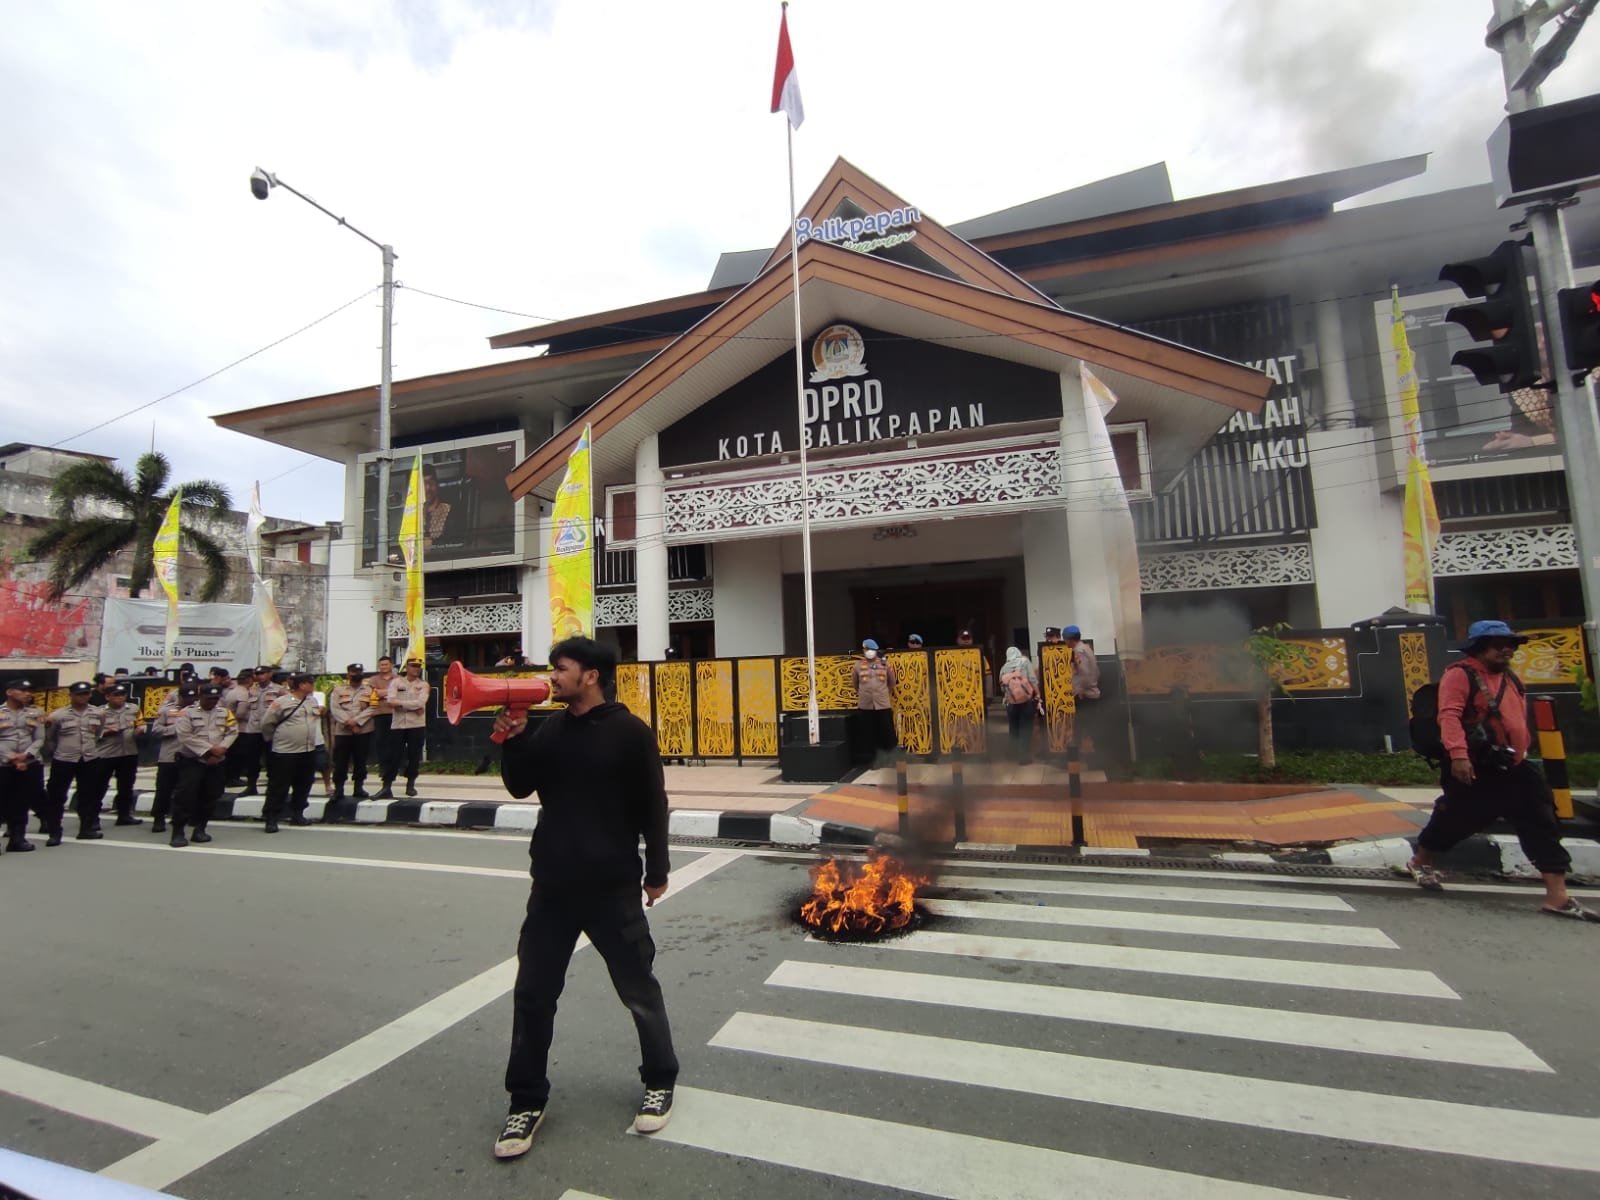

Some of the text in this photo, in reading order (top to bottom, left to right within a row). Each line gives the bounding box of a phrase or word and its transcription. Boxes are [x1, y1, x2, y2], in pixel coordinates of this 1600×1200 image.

[802, 378, 884, 425] DPRD
[1217, 397, 1301, 434] ALAH
[718, 402, 985, 461] KOTA BALIKPAPAN
[1251, 438, 1308, 473] AKU
[183, 647, 220, 658] Puasa
